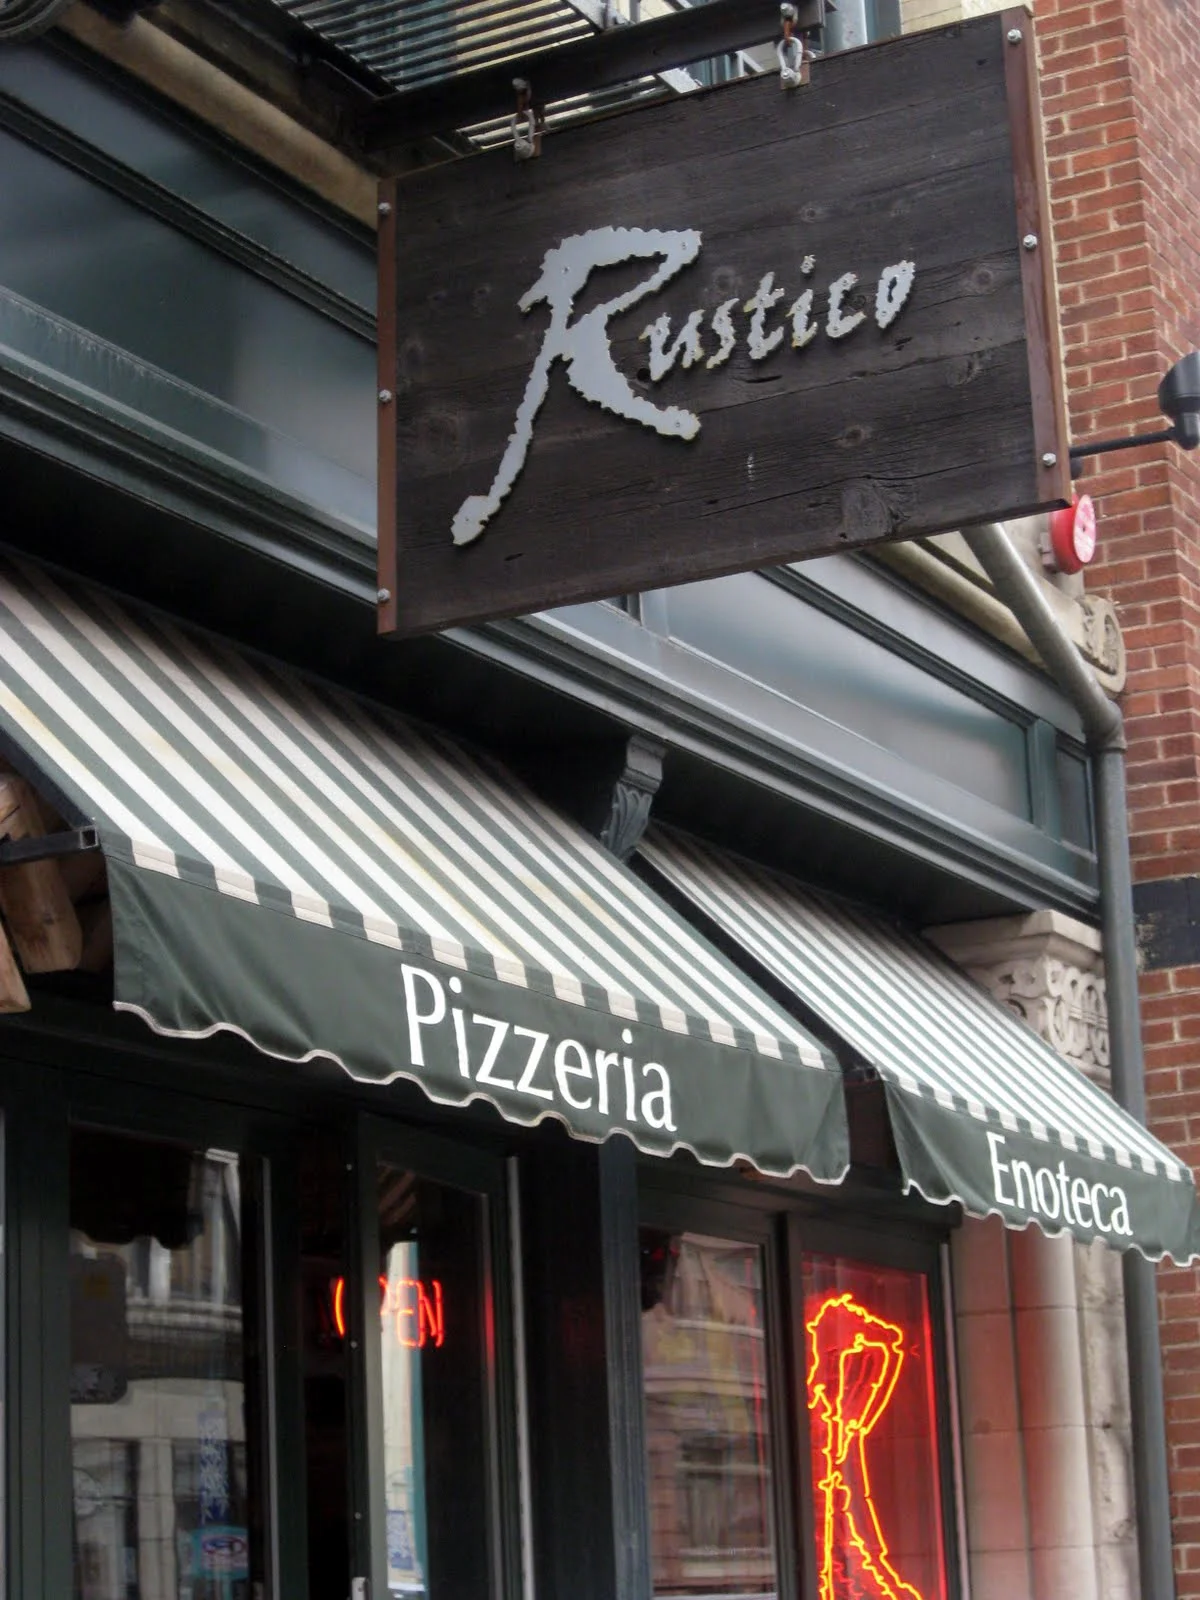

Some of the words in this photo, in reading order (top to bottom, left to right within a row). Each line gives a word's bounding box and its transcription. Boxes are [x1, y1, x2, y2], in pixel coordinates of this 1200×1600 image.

[450, 225, 915, 545] Rustico
[401, 963, 678, 1132] Pizzeria
[986, 1131, 1133, 1236] Enoteca
